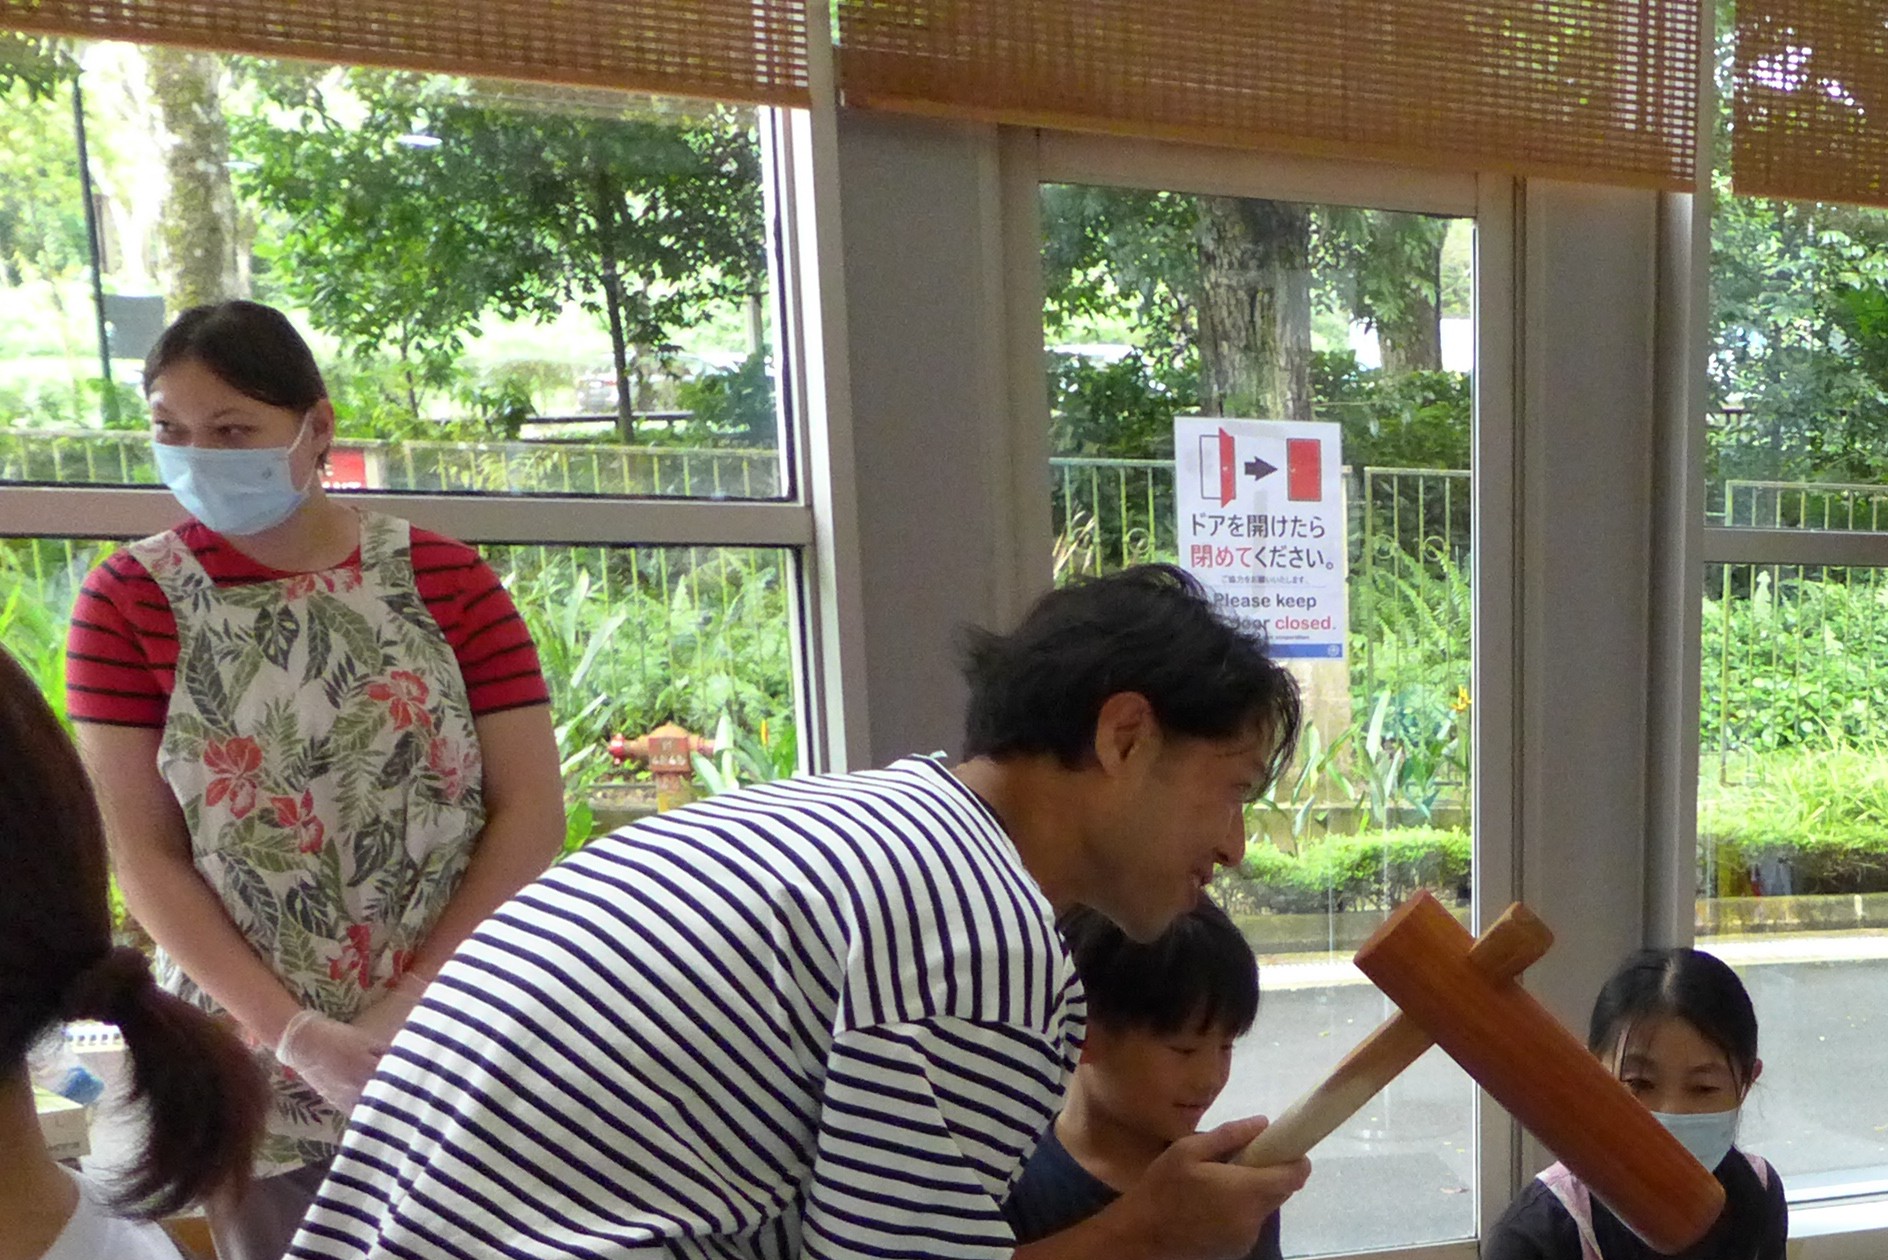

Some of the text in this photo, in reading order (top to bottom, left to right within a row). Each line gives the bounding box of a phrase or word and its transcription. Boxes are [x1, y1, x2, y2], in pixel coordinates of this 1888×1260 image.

[1192, 513, 1325, 538] ドアを開けたら
[1191, 544, 1334, 570] 閉めてください。
[1214, 593, 1317, 610] Please keep
[1275, 616, 1336, 630] closed.
